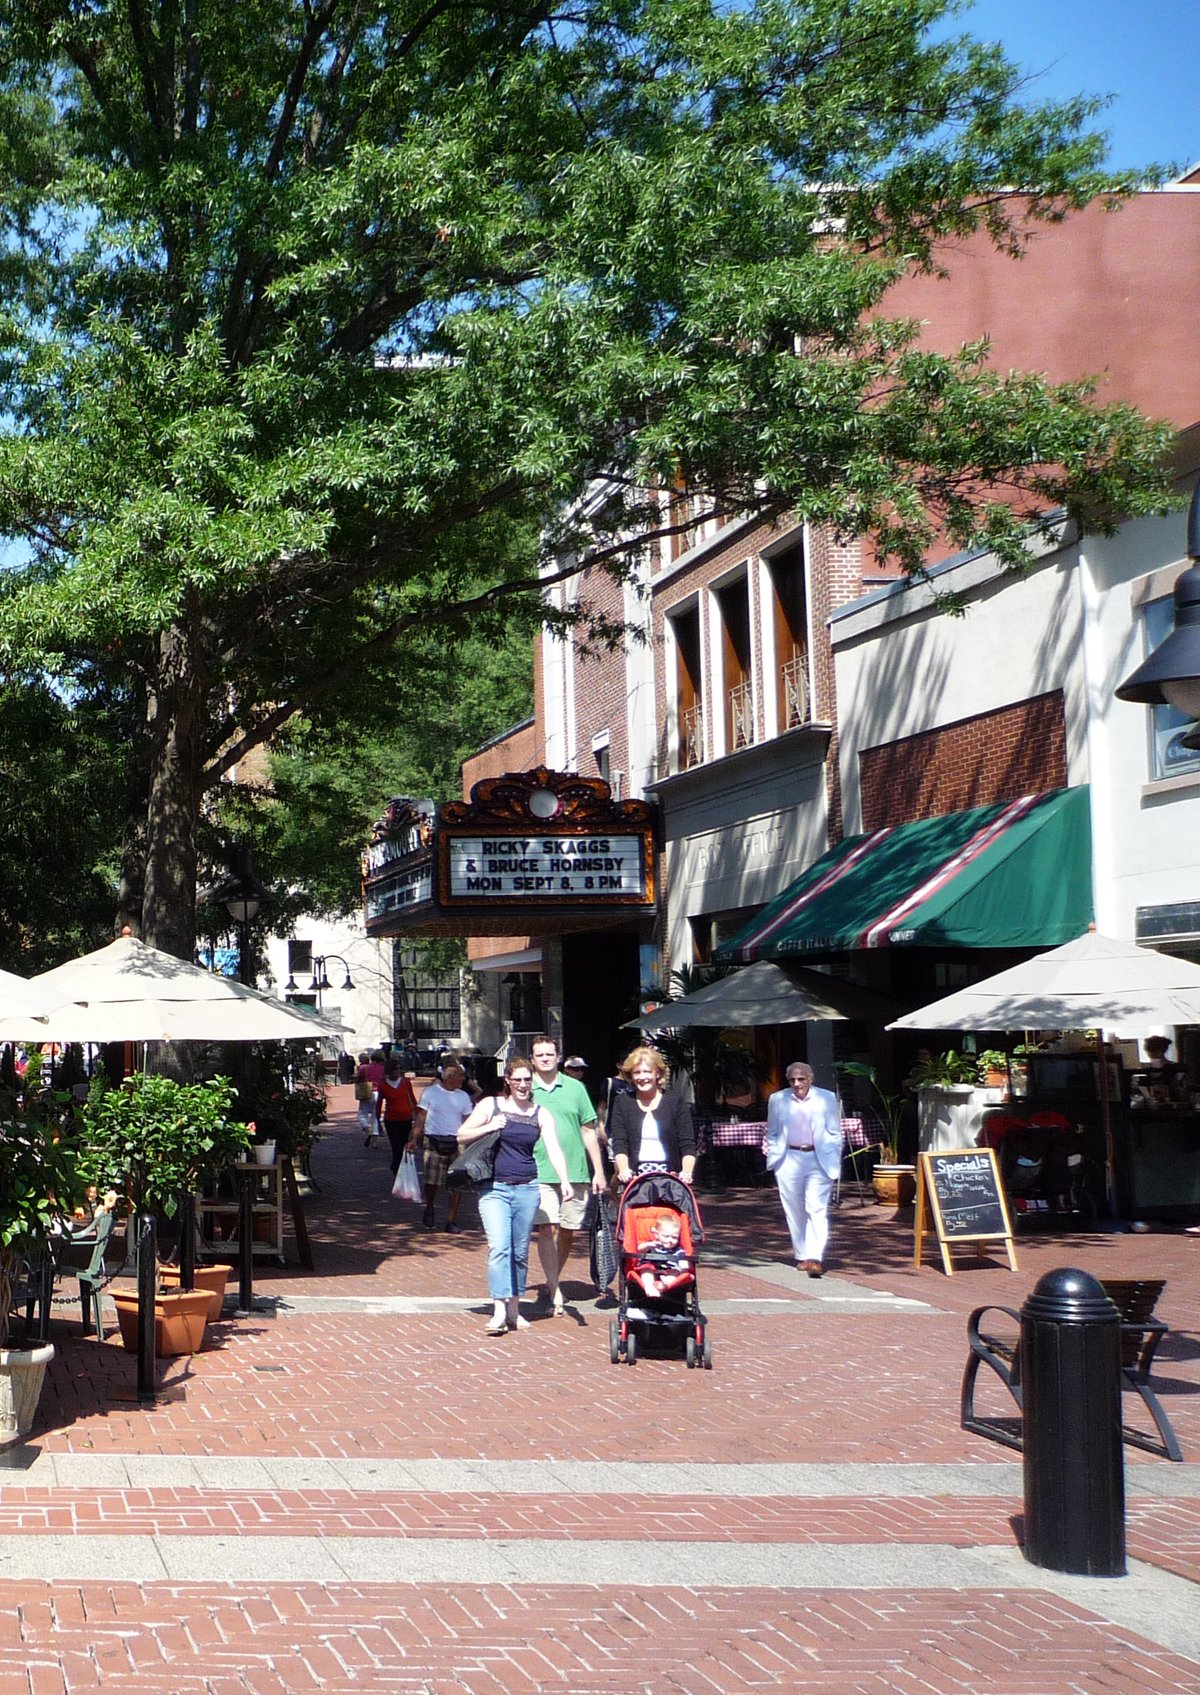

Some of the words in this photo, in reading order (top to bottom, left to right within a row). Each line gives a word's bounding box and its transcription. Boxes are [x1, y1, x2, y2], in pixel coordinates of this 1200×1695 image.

[481, 840, 530, 855] RICKY
[543, 839, 611, 855] SKAGGS
[465, 858, 476, 873] &
[488, 858, 539, 873] BRUCE
[550, 857, 624, 872] HORNSBY
[466, 876, 502, 891] MON
[513, 876, 554, 890] SEPT
[560, 876, 574, 891] 8,
[936, 1155, 990, 1179] Specials
